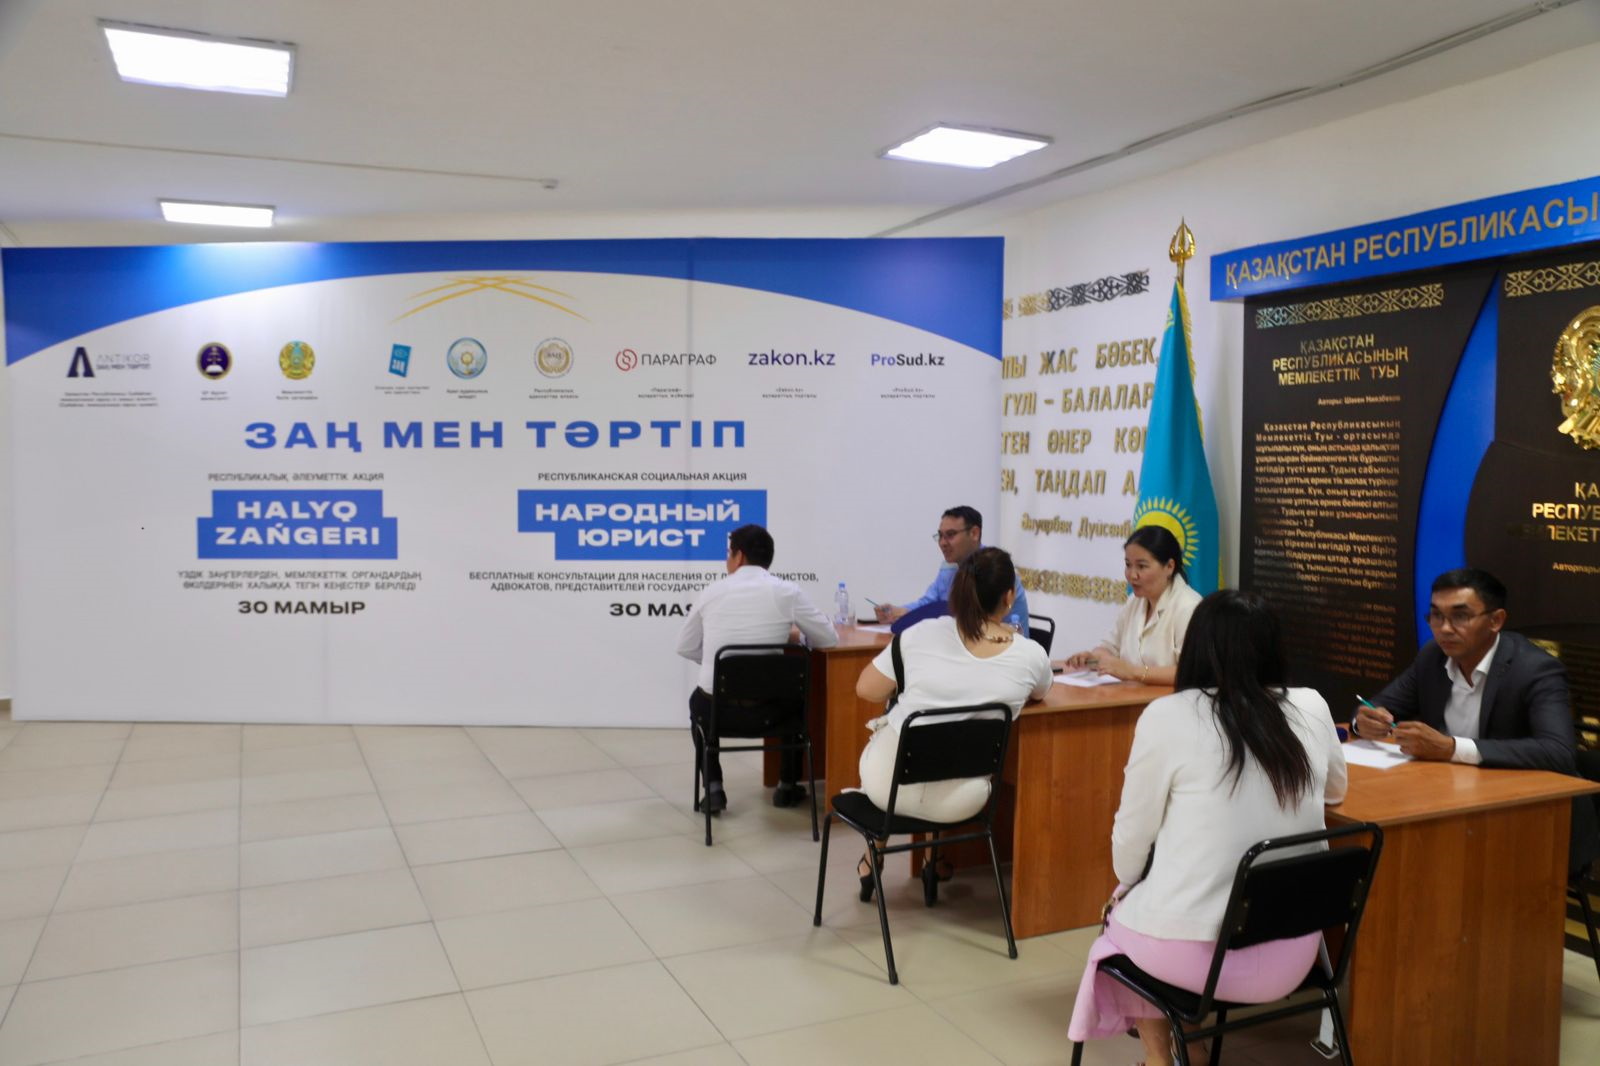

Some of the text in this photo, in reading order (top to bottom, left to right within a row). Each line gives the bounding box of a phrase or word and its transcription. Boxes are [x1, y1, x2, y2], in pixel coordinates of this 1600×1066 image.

[1226, 191, 1599, 289] ҚАЗАҚСТАН РЕСПУБЛИКАСЫ
[1300, 333, 1375, 355] ҚАЗАҚСТАН
[641, 353, 717, 366] ПАРАГРАФ
[748, 349, 836, 366] zakon.kz
[870, 353, 945, 366] ProSud.kz
[1039, 347, 1079, 375] ЖАС
[1095, 337, 1160, 369] БӨБЕК,
[1272, 346, 1409, 371] РЕСПУБЛИКАСЫНЫҢ
[1278, 365, 1399, 386] МЕМЛЕКЕТТІК ТУЫ
[1061, 382, 1155, 413] БАЛАЛАР
[245, 420, 745, 452] ЗАҢ МЕН ТӘРТІП
[1047, 429, 1092, 454] ӨНЕР
[1315, 432, 1334, 443] Туы
[208, 473, 384, 483] РЕСПУБЛИКАЛЫҚ ӘЛЕУМЕТТІК АКЦИЯ
[538, 472, 747, 482] РЕСПУБЛИКАНСКАЯ СОЦИАЛЬНАЯ АКЦИЯ
[1035, 469, 1106, 498] ТАҢДАП
[1122, 470, 1141, 496] А
[237, 501, 357, 522] HALYQ
[535, 499, 740, 523] НАРОДНЫЙ
[215, 523, 379, 545] ZAŃGERI
[578, 529, 706, 547] ЮРИСТ
[285, 571, 347, 580] МЕМЛЕКЕТТІК
[469, 572, 534, 580] БЕСПЛАТНЫЕ
[537, 572, 615, 582] КОНСУЛЬТАЦИИ
[618, 573, 639, 582] ДЛЯ
[642, 573, 701, 582] НАСЕЛЕНИЯ
[705, 573, 717, 581] ОТ
[771, 572, 819, 582] РИСТОВ,
[296, 582, 320, 590] ТЕГІН
[491, 582, 706, 592] АДВОКАТОВ, ПРЕДСТАВИТЕЛЕЙ ГОСУДАРСТ
[238, 601, 366, 614] 30 МАМЫР
[610, 603, 641, 616] 30
